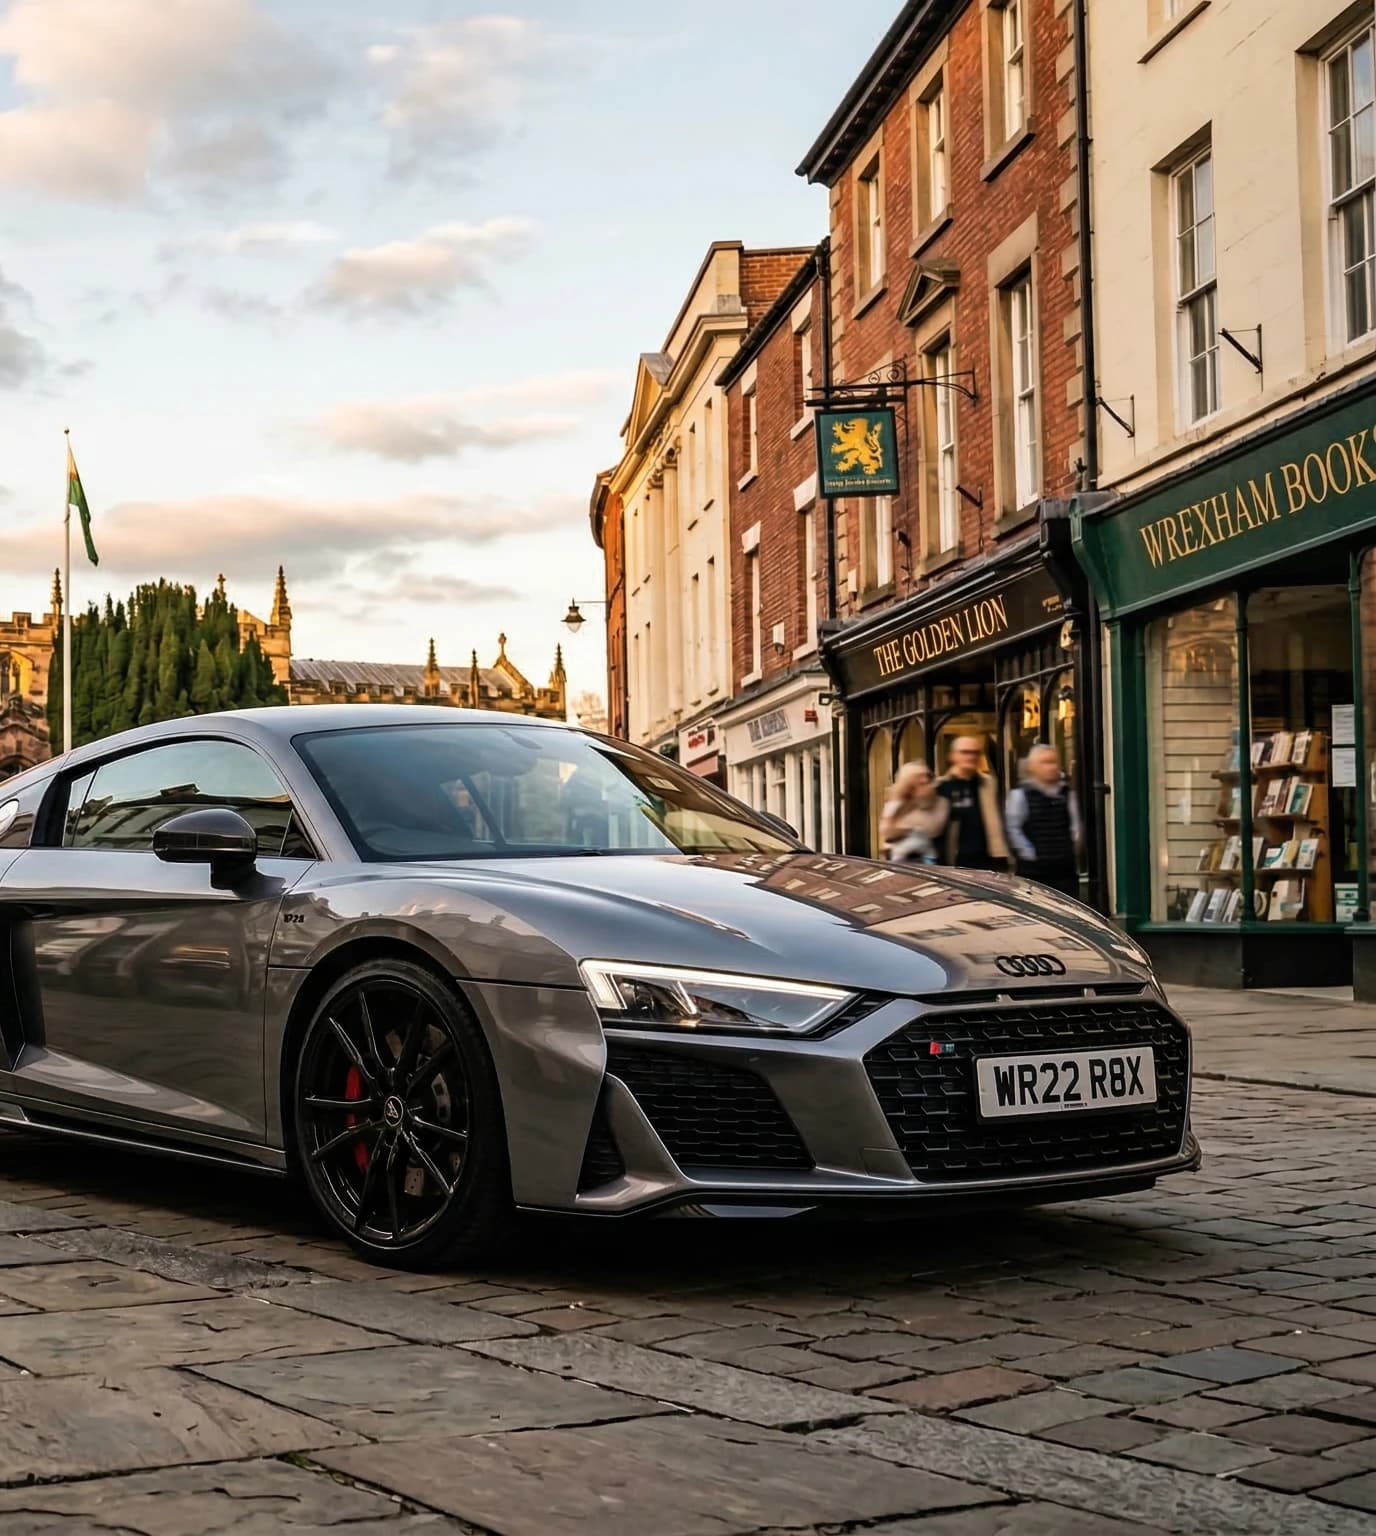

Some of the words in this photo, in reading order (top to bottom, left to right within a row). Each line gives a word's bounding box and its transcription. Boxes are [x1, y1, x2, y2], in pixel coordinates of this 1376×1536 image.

[1139, 472, 1281, 569] WREXHAM
[1280, 424, 1376, 514] BOOK
[874, 639, 905, 676] THE
[903, 613, 966, 665] GOLDEN
[964, 594, 1009, 643] LION
[993, 1060, 1082, 1107] WR22
[1088, 1055, 1145, 1100] R8X
